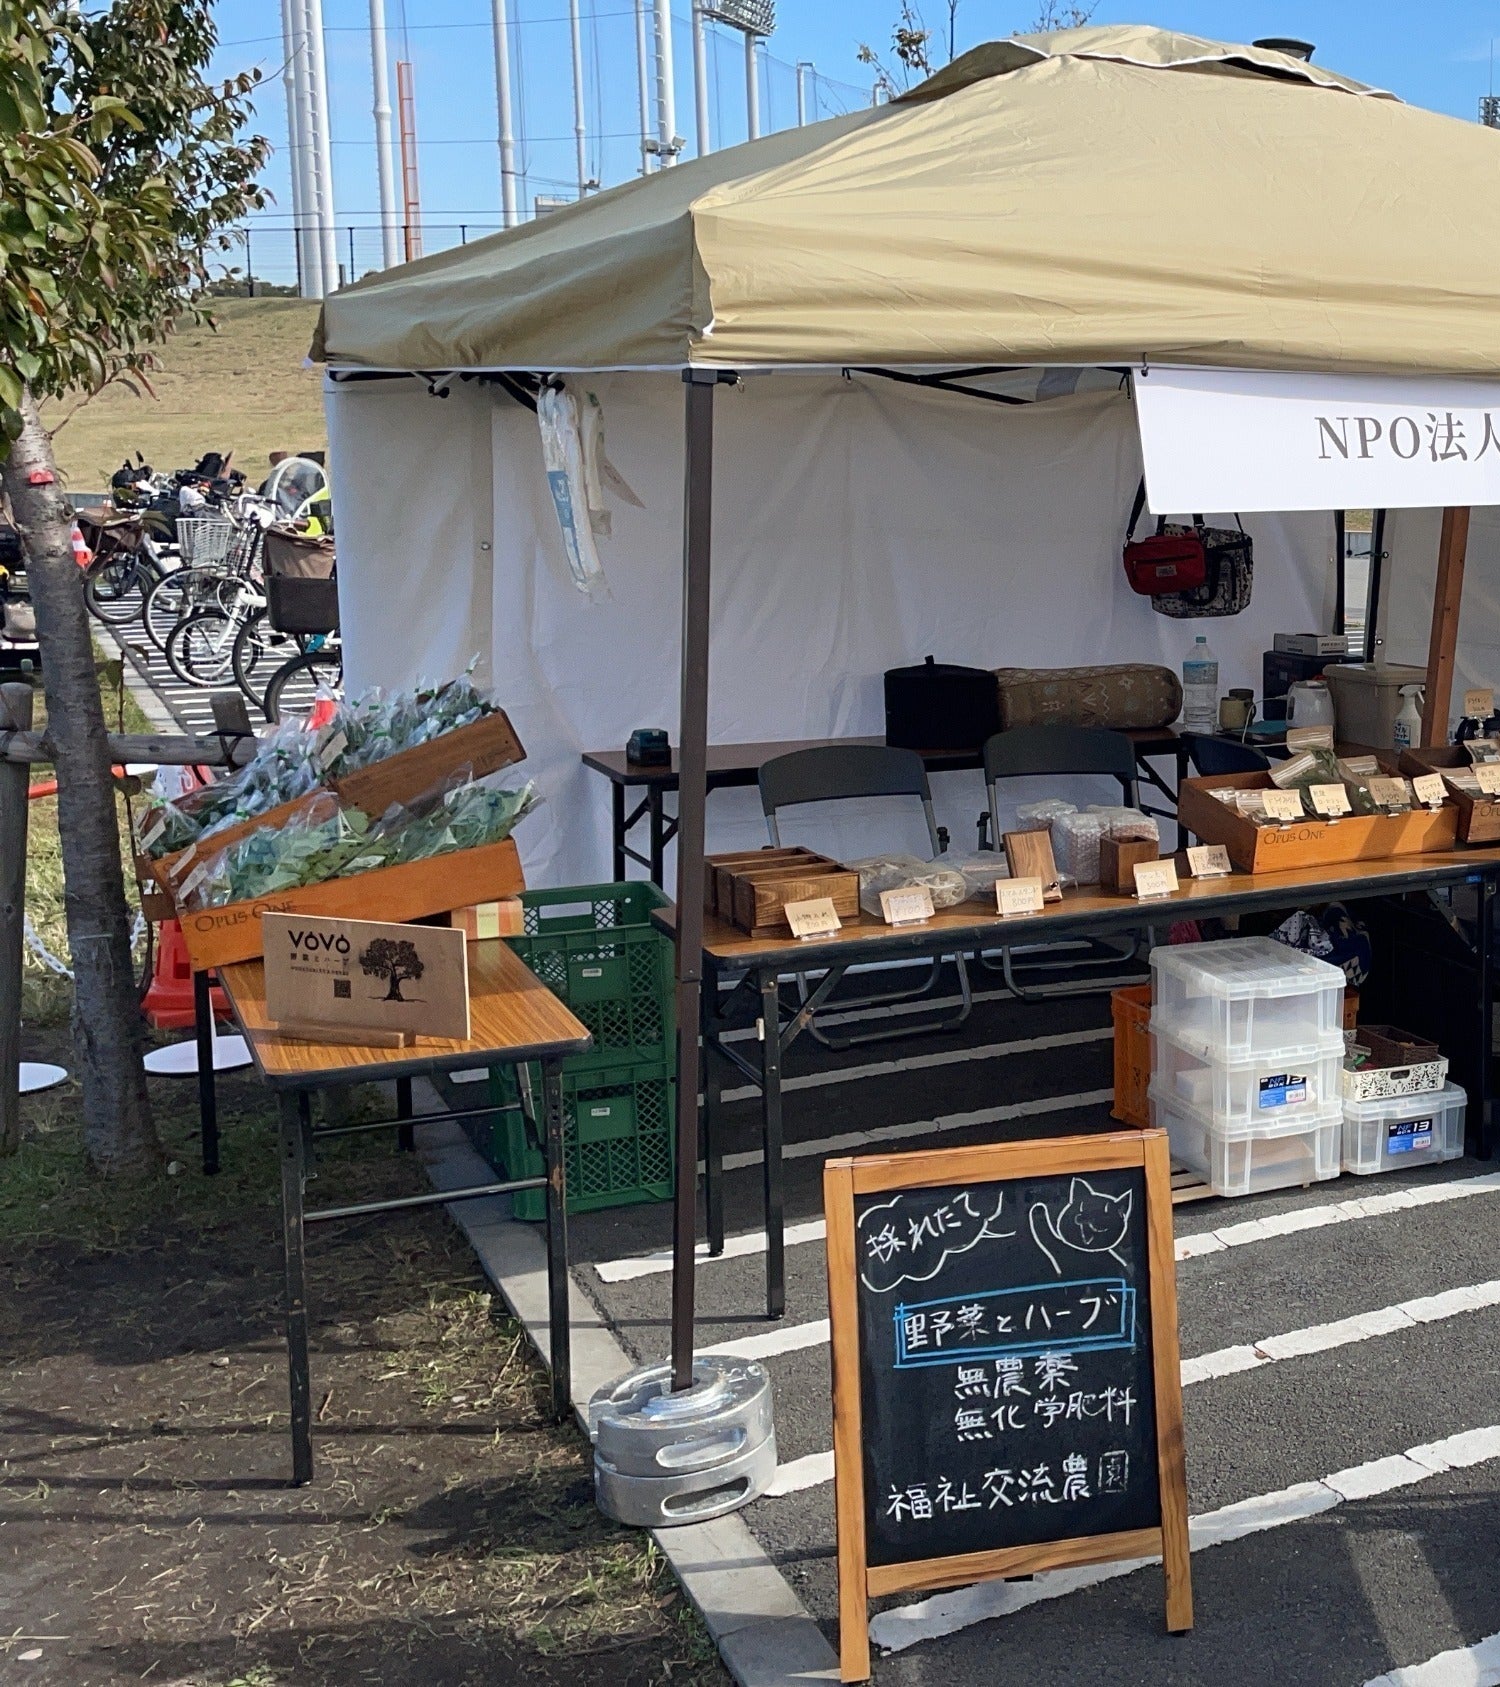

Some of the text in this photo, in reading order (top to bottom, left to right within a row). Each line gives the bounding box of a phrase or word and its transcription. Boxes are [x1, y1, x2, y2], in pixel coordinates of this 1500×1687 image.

[1413, 1121, 1430, 1132] 13
[866, 1191, 980, 1263] 採れたて
[904, 1293, 1118, 1350] 野菜とハーブ
[954, 1351, 1079, 1399] 無農薬
[954, 1386, 1137, 1441] 無化学肥料
[886, 1449, 1129, 1521] 福祉交流農園
